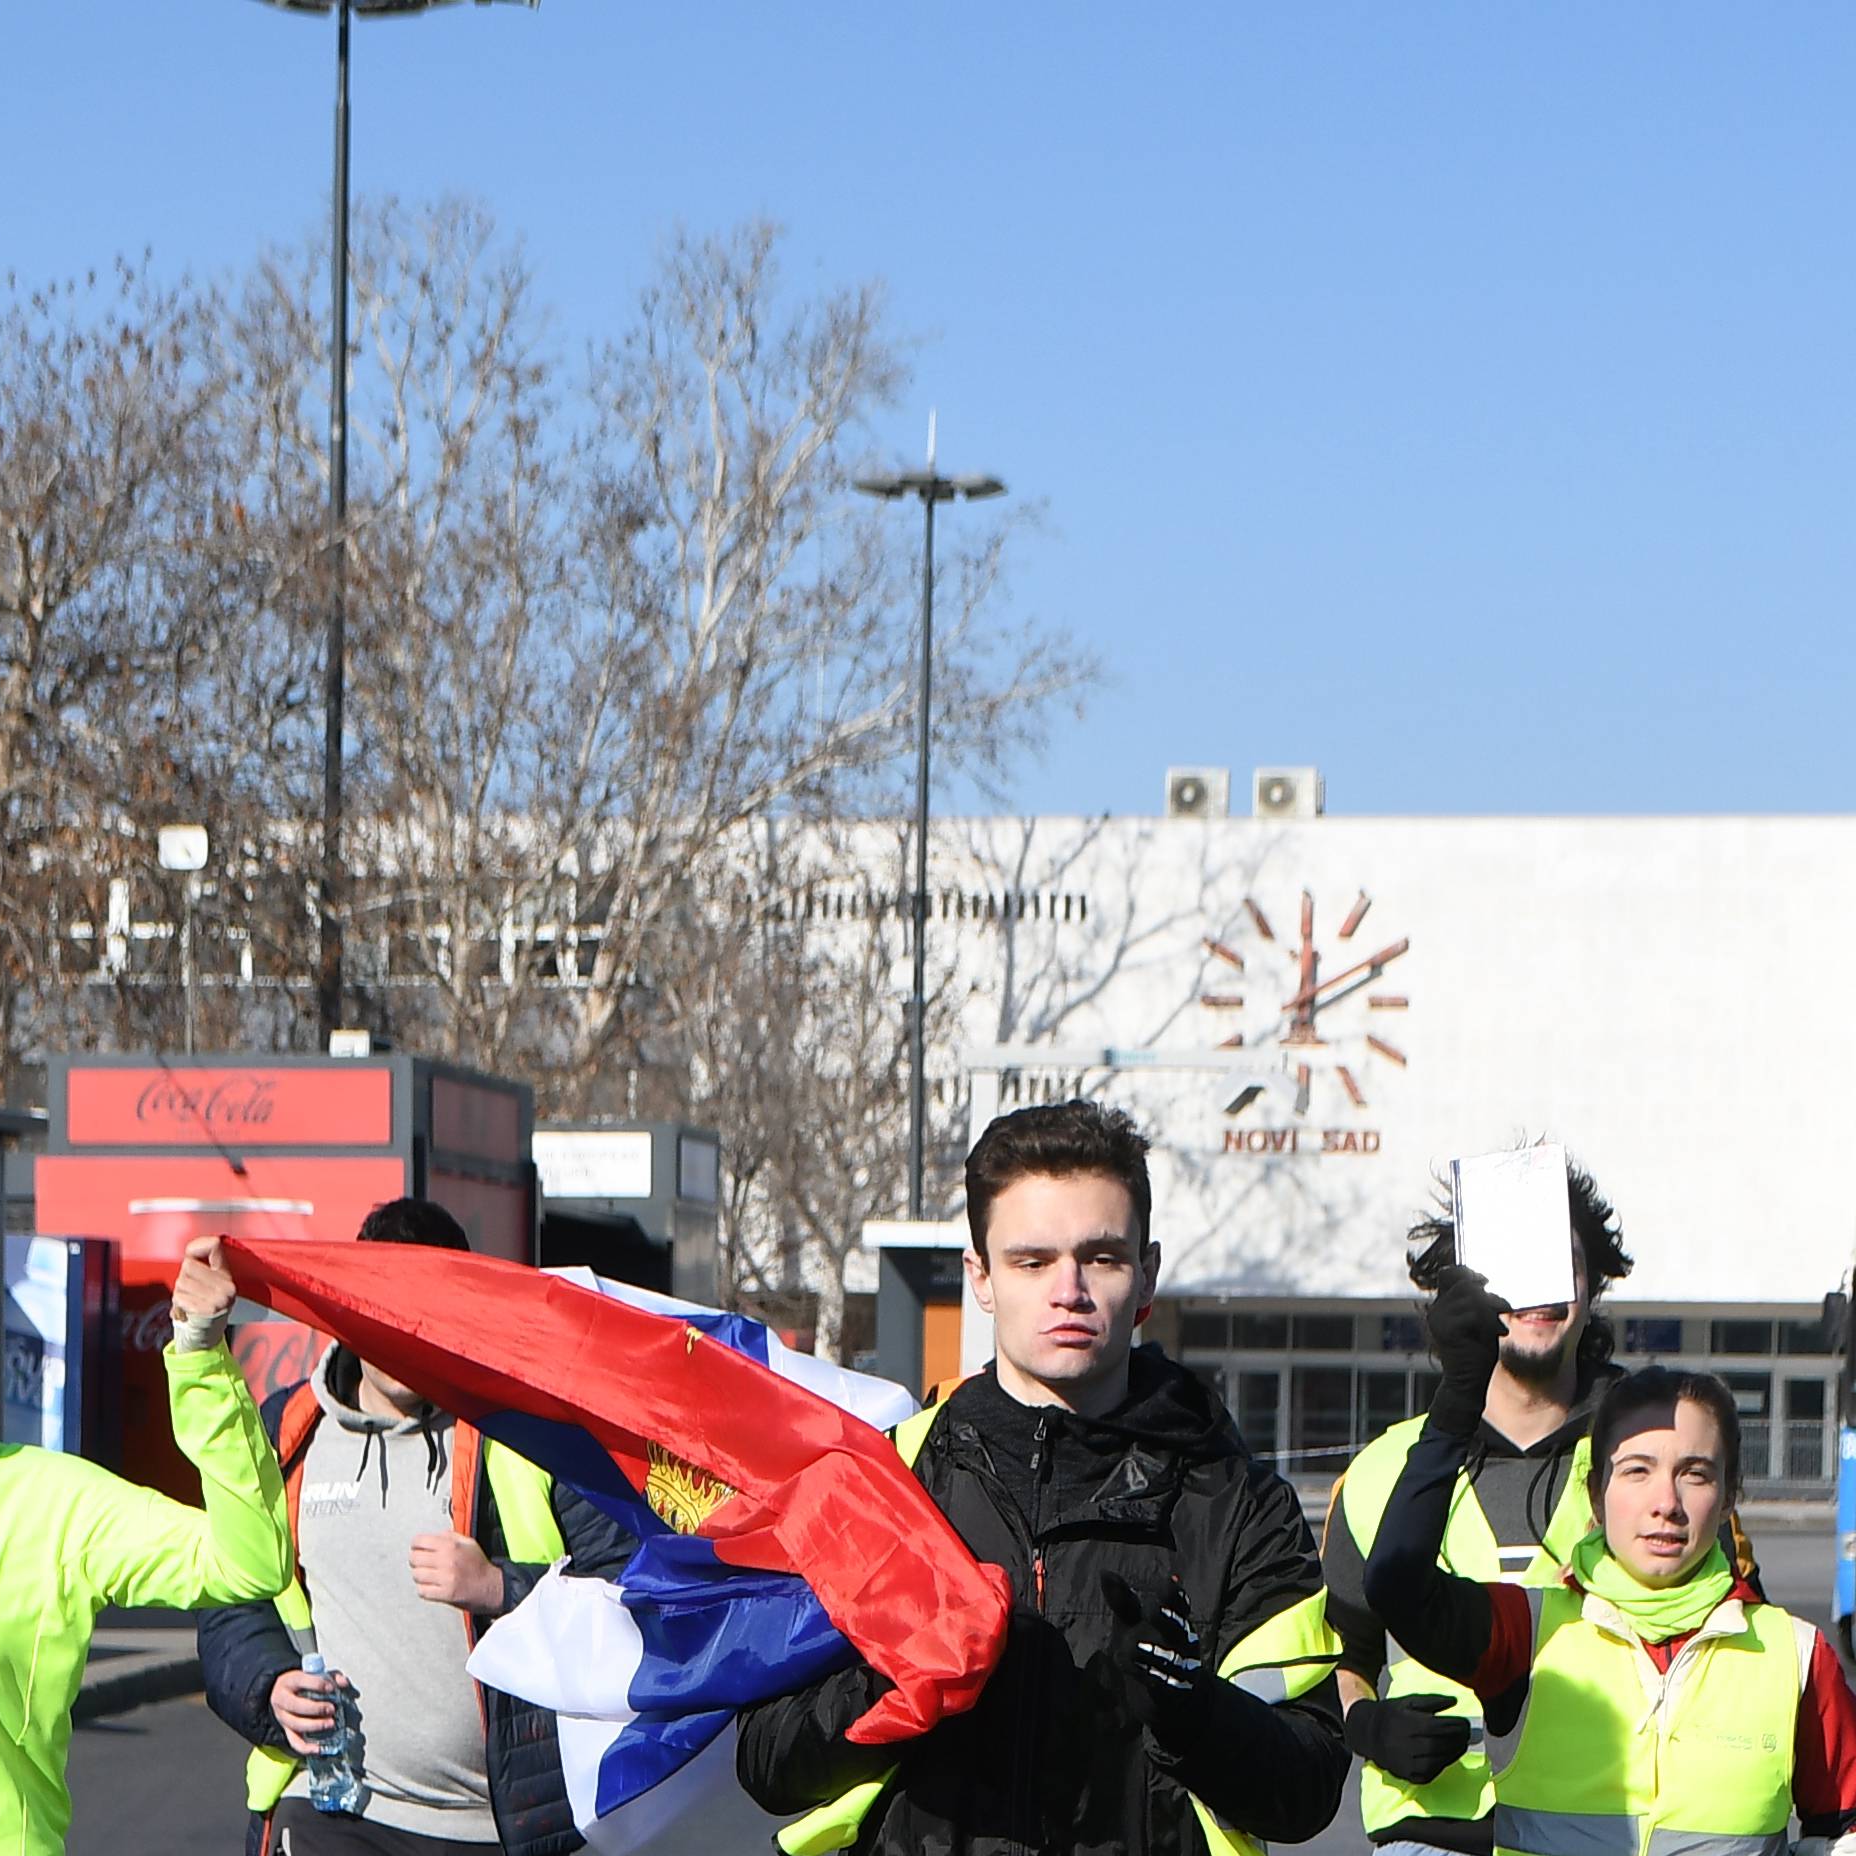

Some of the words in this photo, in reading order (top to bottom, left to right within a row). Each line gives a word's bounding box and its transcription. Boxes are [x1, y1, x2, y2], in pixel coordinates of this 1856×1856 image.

[1224, 1129, 1298, 1152] NOVI
[1322, 1129, 1381, 1152] SAD
[303, 1482, 361, 1503] RUN
